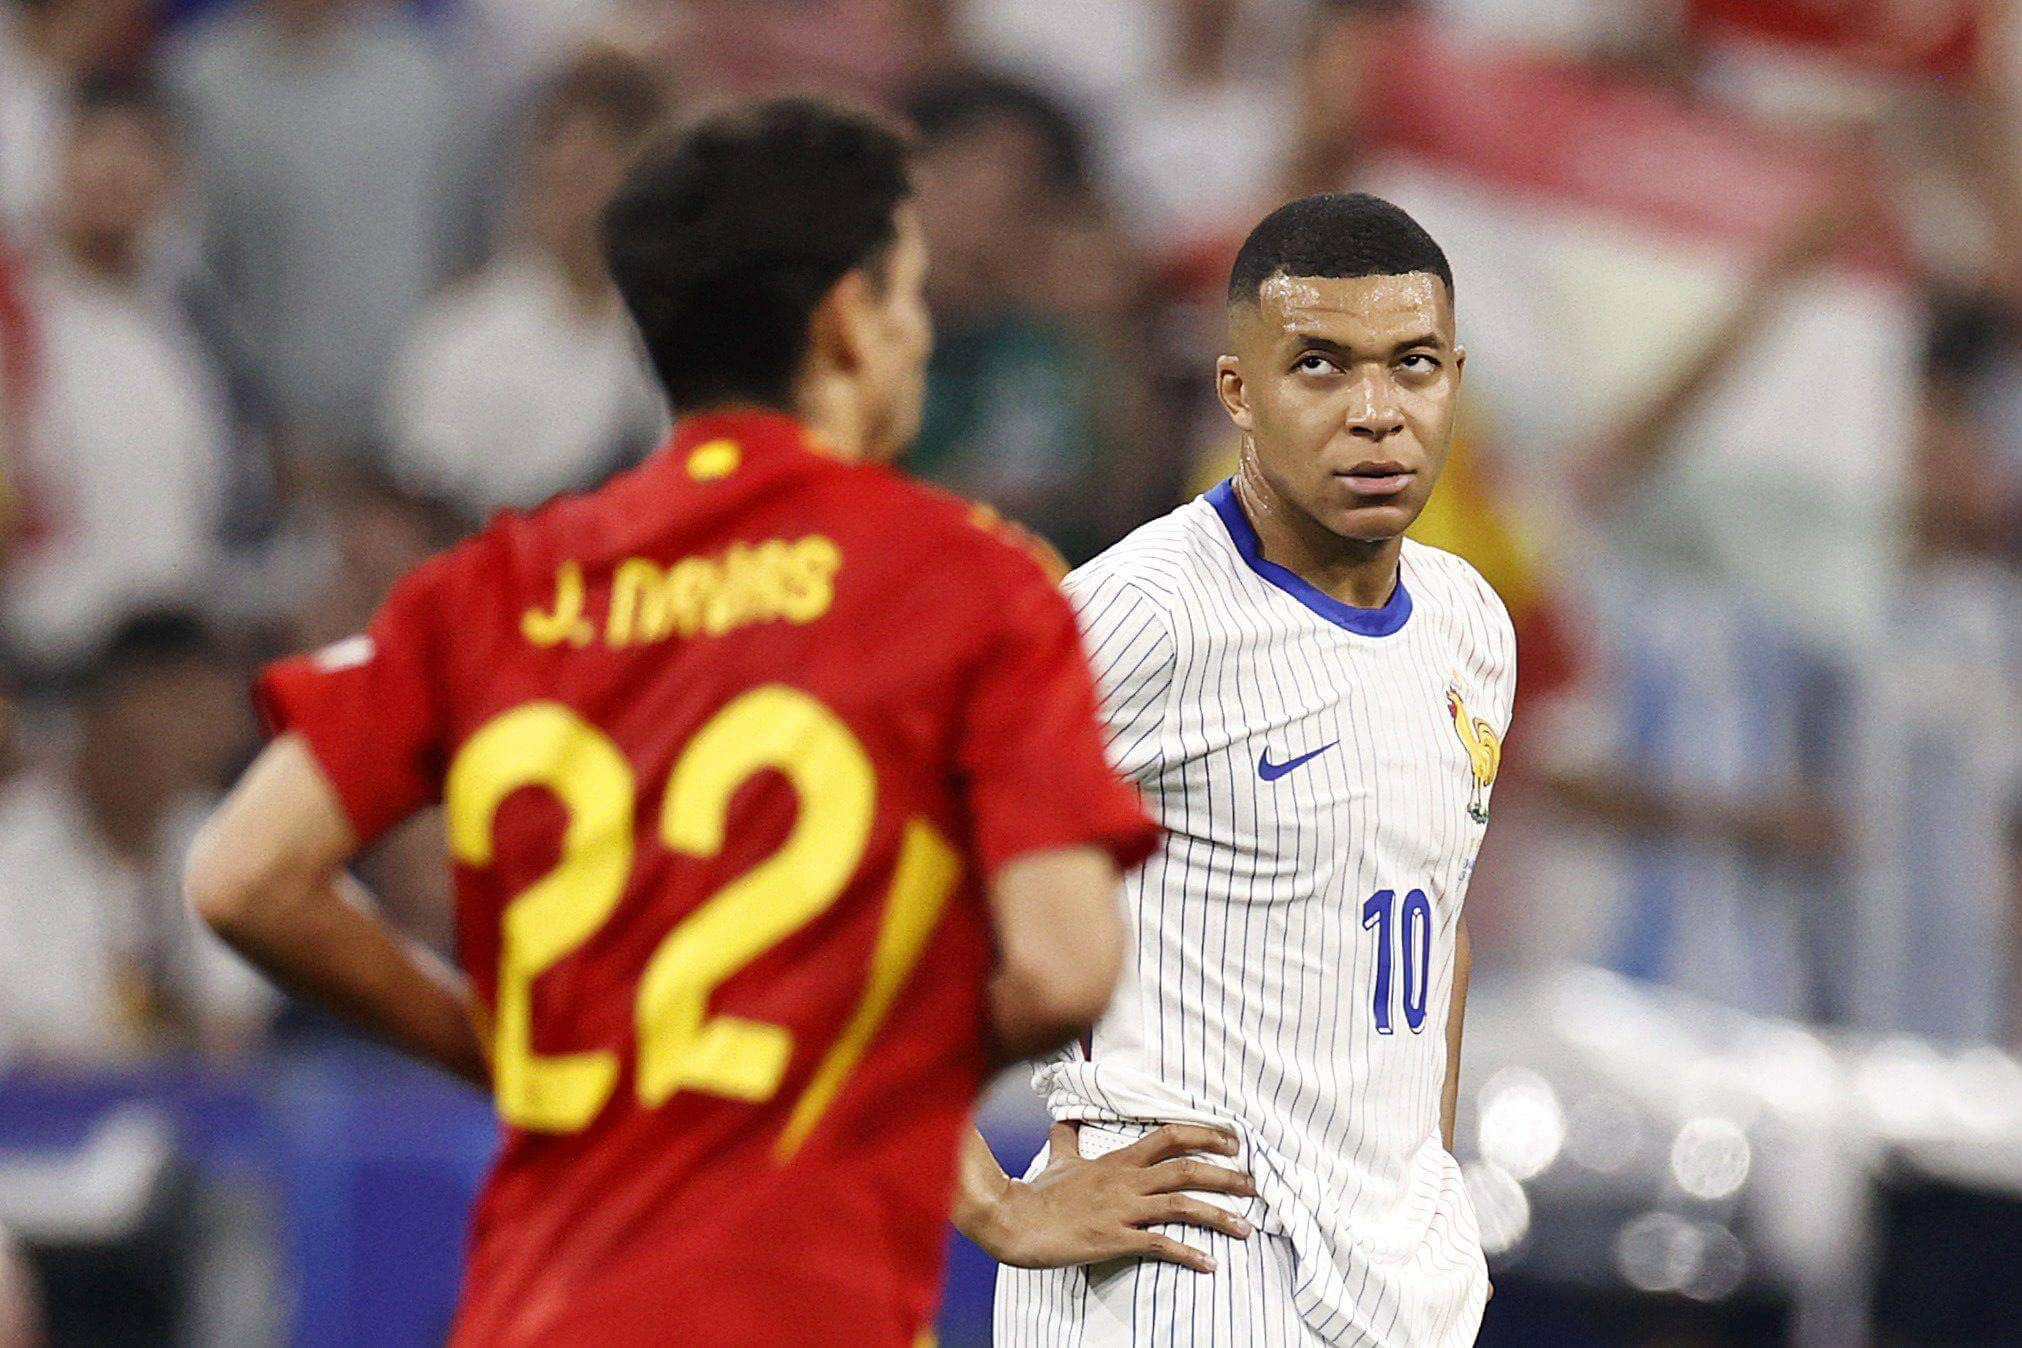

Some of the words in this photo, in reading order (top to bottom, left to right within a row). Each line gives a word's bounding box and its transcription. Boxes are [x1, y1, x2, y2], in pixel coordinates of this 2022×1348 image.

[522, 559, 596, 648] J.
[446, 684, 877, 1133] 22
[1362, 888, 1431, 1035] 10
